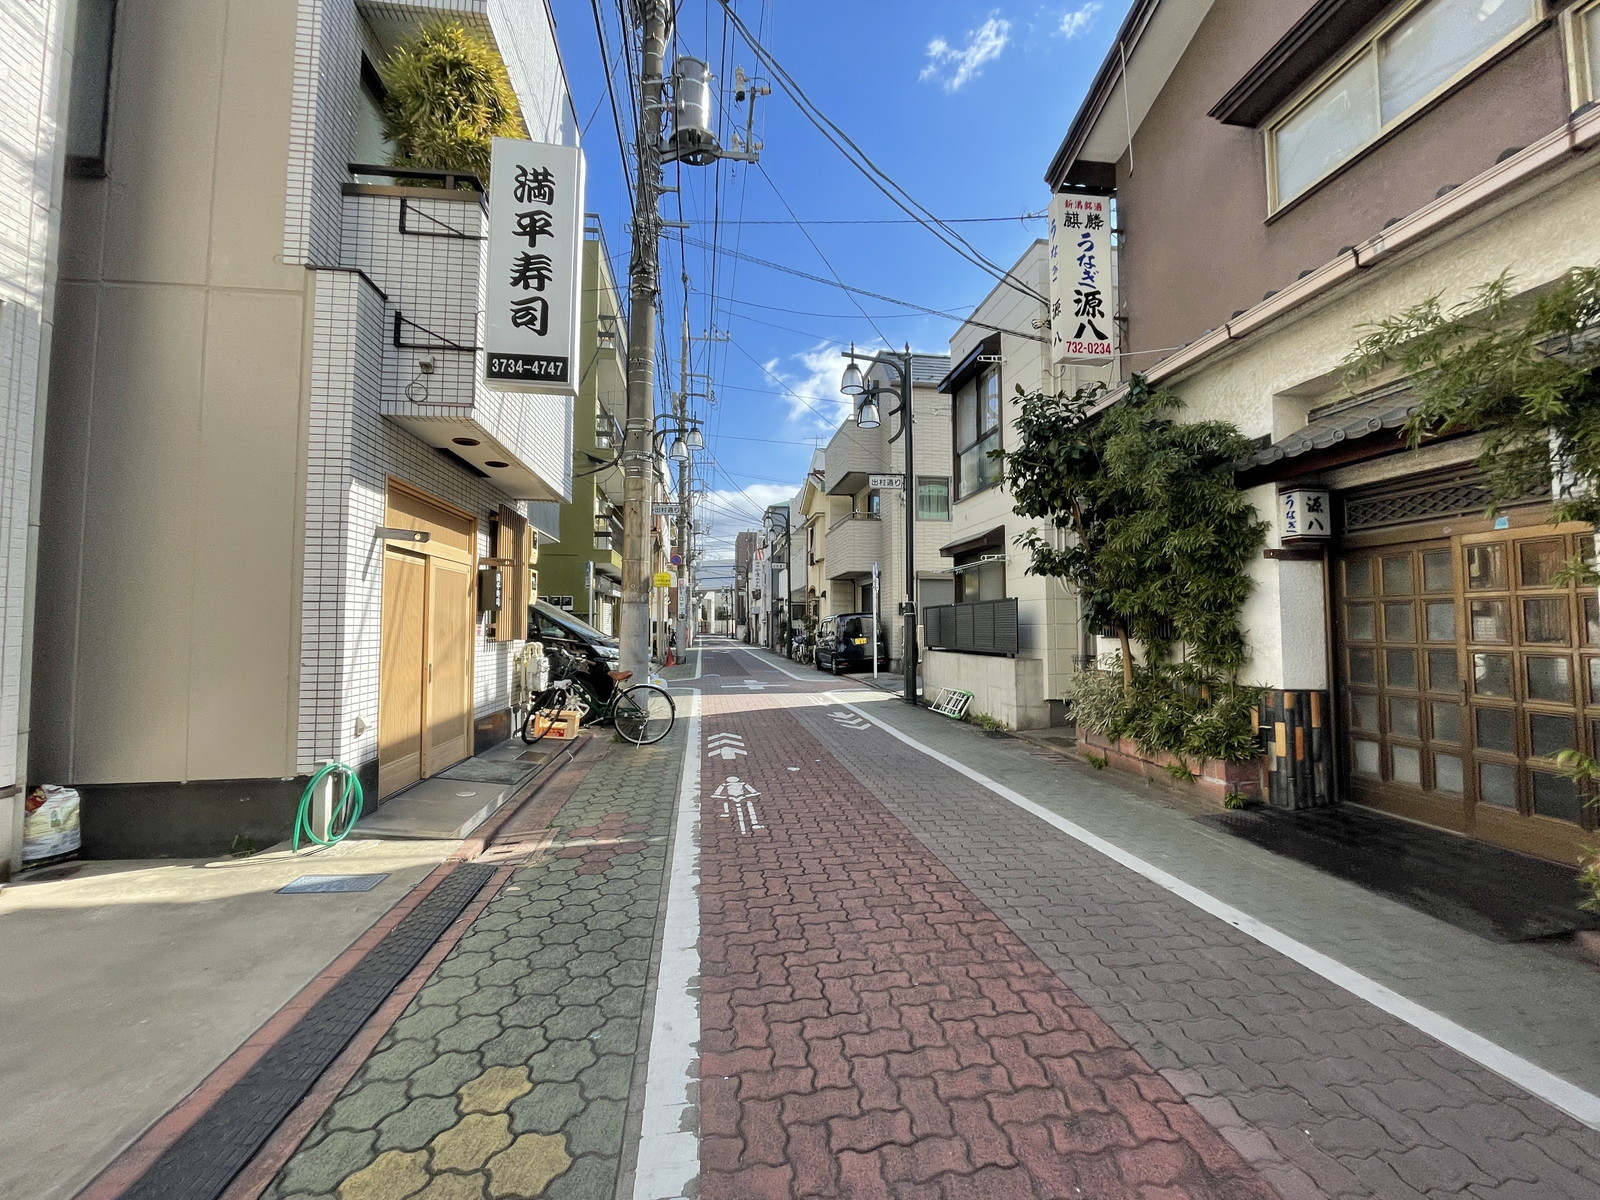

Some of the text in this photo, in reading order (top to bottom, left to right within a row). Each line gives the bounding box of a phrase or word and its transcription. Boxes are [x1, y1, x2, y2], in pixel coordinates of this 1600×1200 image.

[509, 164, 556, 337] 満平寿司
[1076, 231, 1099, 290] うなぎ
[1072, 289, 1109, 341] 源八
[1066, 341, 1112, 356] 732-0234
[491, 358, 563, 377] 3734-4747
[871, 478, 901, 487] 出村通り
[1285, 494, 1298, 533] うなぎ
[1305, 495, 1324, 531] 源八
